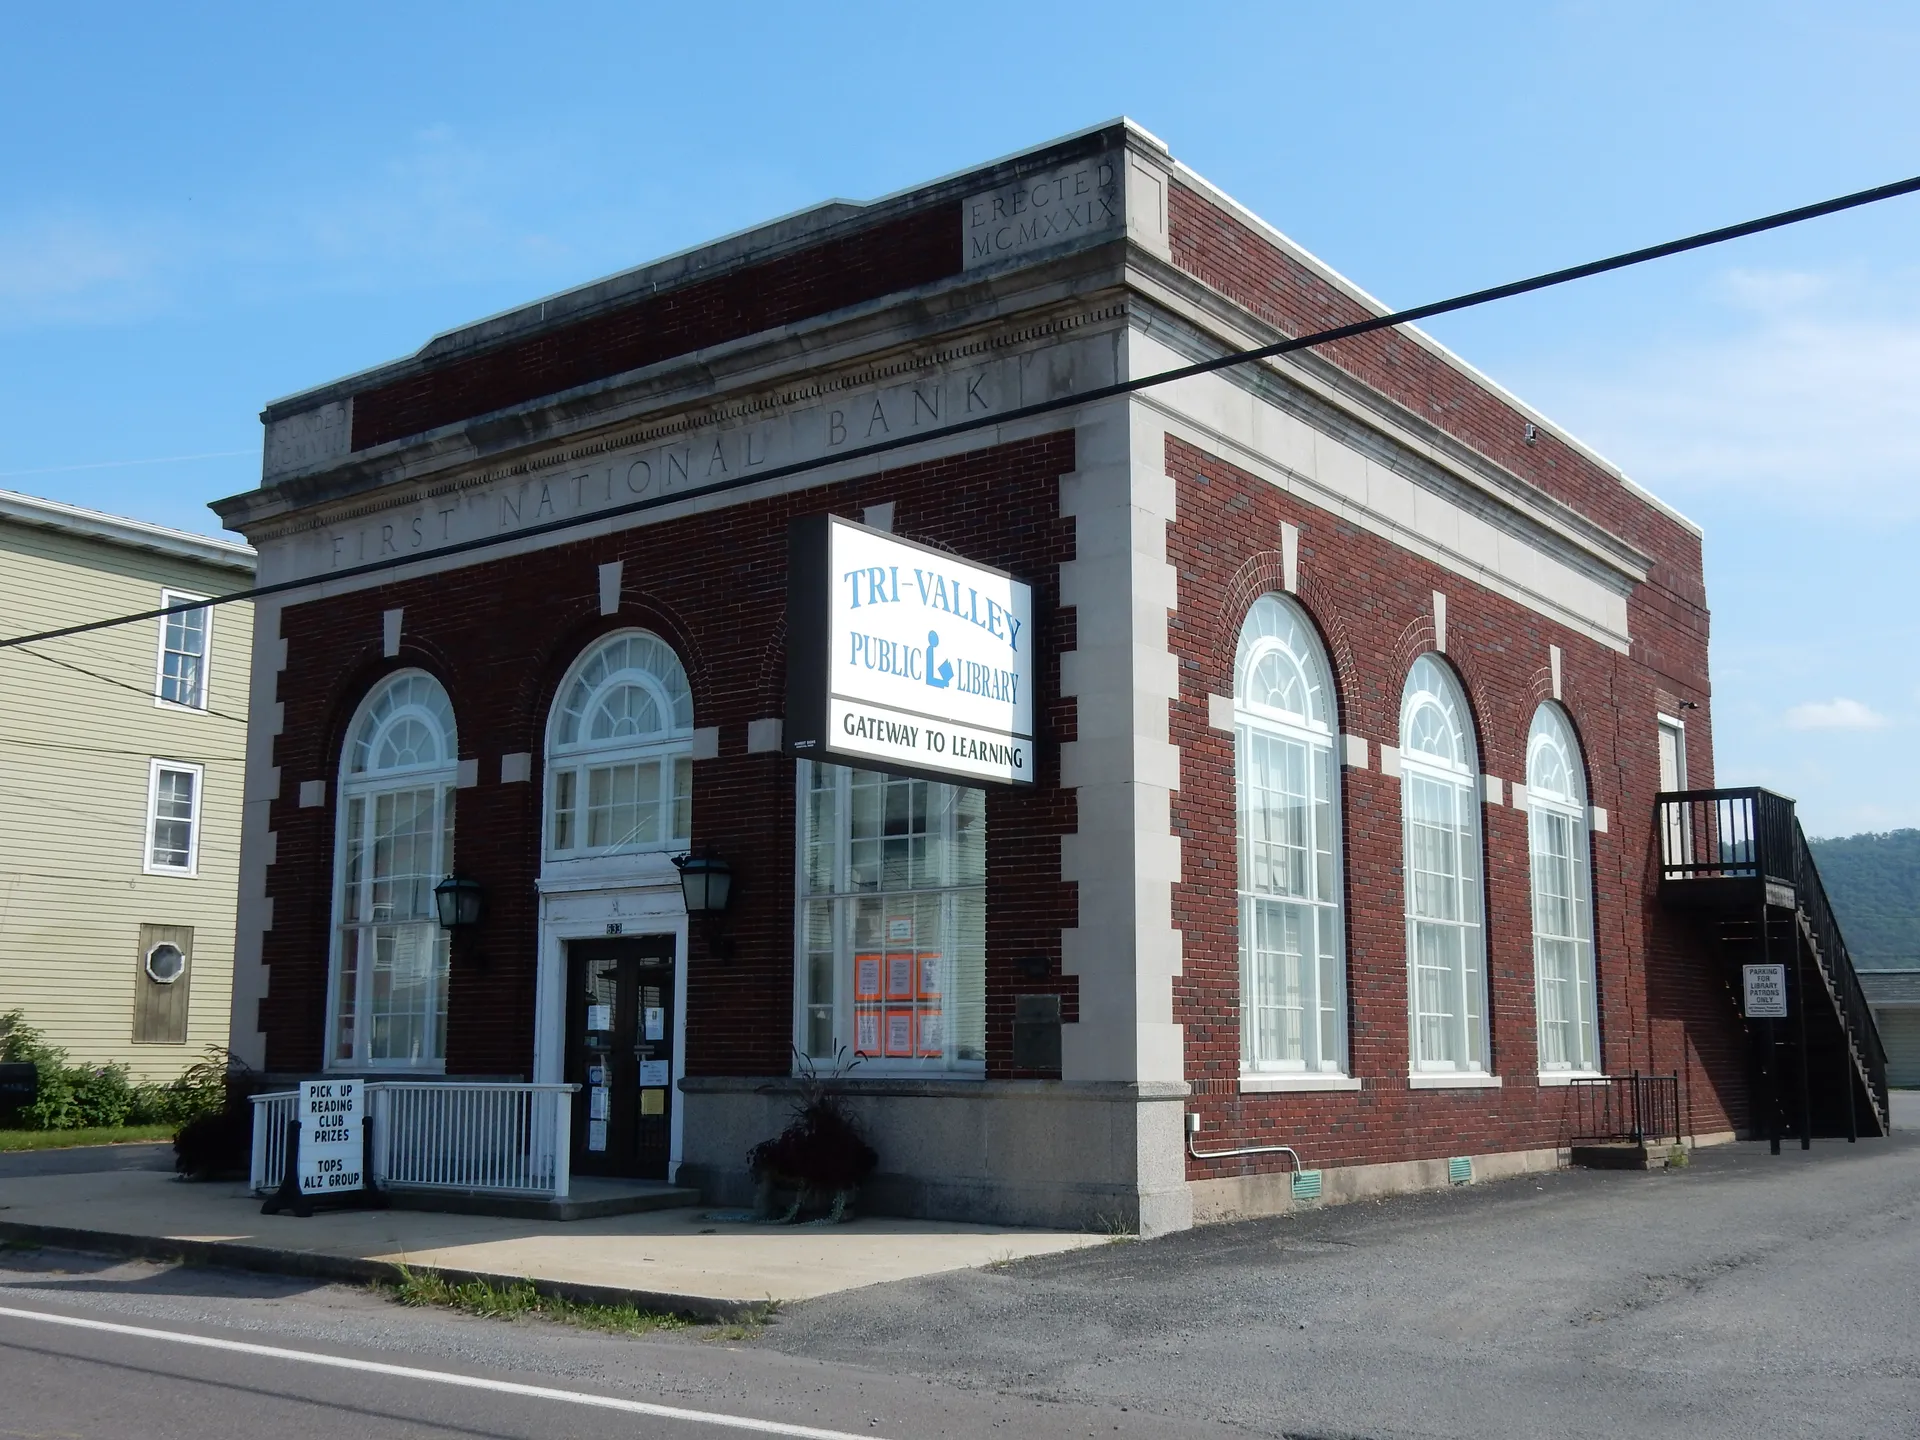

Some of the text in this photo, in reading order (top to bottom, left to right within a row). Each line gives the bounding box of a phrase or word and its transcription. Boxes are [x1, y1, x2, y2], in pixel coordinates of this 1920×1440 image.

[971, 164, 1114, 229] ERECTED
[971, 195, 1116, 259] MCMXXIX
[331, 372, 988, 567] FIRST NATIONAL BANK
[844, 565, 1022, 653] TRI-VALLEY
[849, 631, 1019, 705] PUBLIC LIBRARY
[843, 713, 1023, 768] GATEWAY TO LEARNING
[310, 1084, 353, 1098] PICK UP
[311, 1099, 353, 1113] READING
[314, 1129, 349, 1142] PRIZES
[319, 1115, 344, 1128] CLUB
[304, 1172, 360, 1189] ALZ GROUP
[318, 1159, 343, 1173] TOPS
